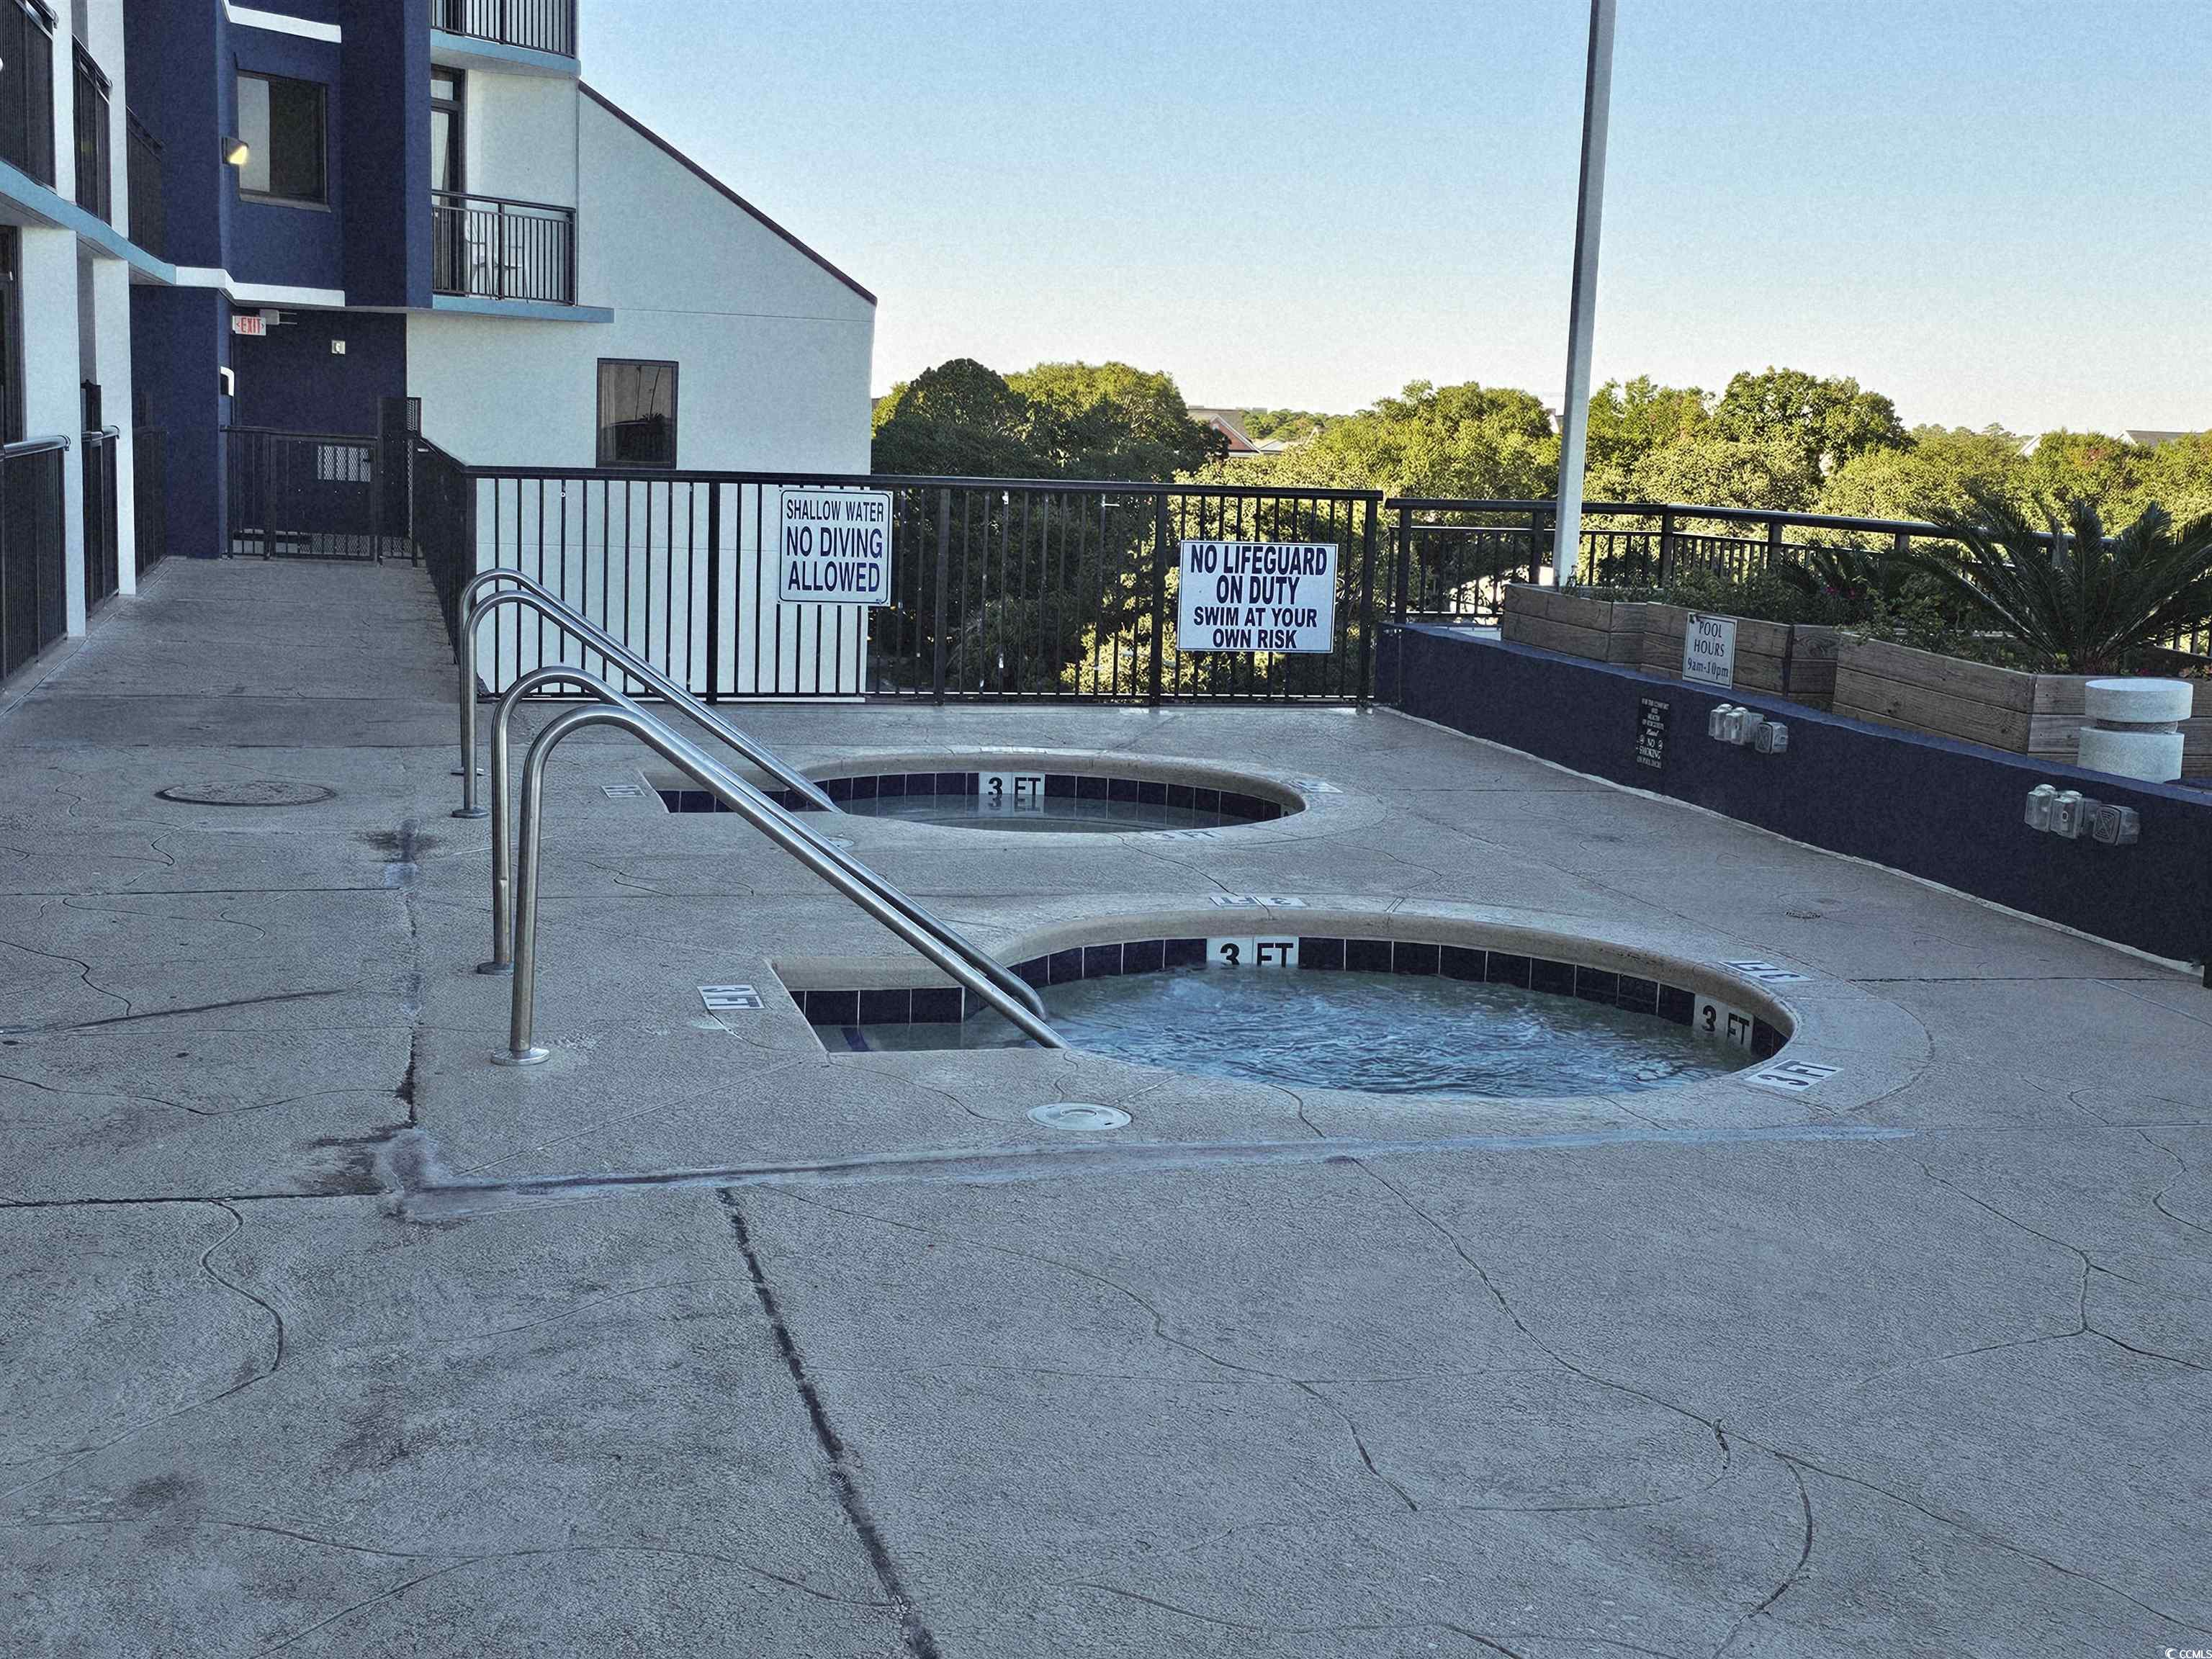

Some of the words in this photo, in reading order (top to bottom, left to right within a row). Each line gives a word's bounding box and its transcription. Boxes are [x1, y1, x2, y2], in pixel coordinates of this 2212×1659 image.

[241, 318, 261, 333] EXIT
[786, 499, 841, 521] SHALLOW
[846, 501, 884, 522] WATER
[786, 526, 813, 557] NO
[820, 527, 882, 558] DIVING
[1190, 544, 1217, 574] NO
[1223, 546, 1327, 575] LIFEGUARD
[788, 561, 880, 592] ALLOWED
[1216, 575, 1243, 603] ON
[1249, 576, 1300, 605] DUTY
[1193, 606, 1238, 626] SWIM
[1244, 608, 1266, 626] AT
[1272, 608, 1318, 628] YOUR
[1213, 629, 1251, 648] OWN
[1258, 629, 1297, 649] RISK
[1699, 621, 1722, 638] POOL
[1694, 639, 1725, 657] HOURS
[988, 777, 1003, 796] 3
[1015, 777, 1041, 796] FT
[1220, 943, 1240, 966] 3
[1257, 943, 1294, 968] FT
[1701, 1004, 1717, 1033] 3
[1727, 1012, 1750, 1045] FT
